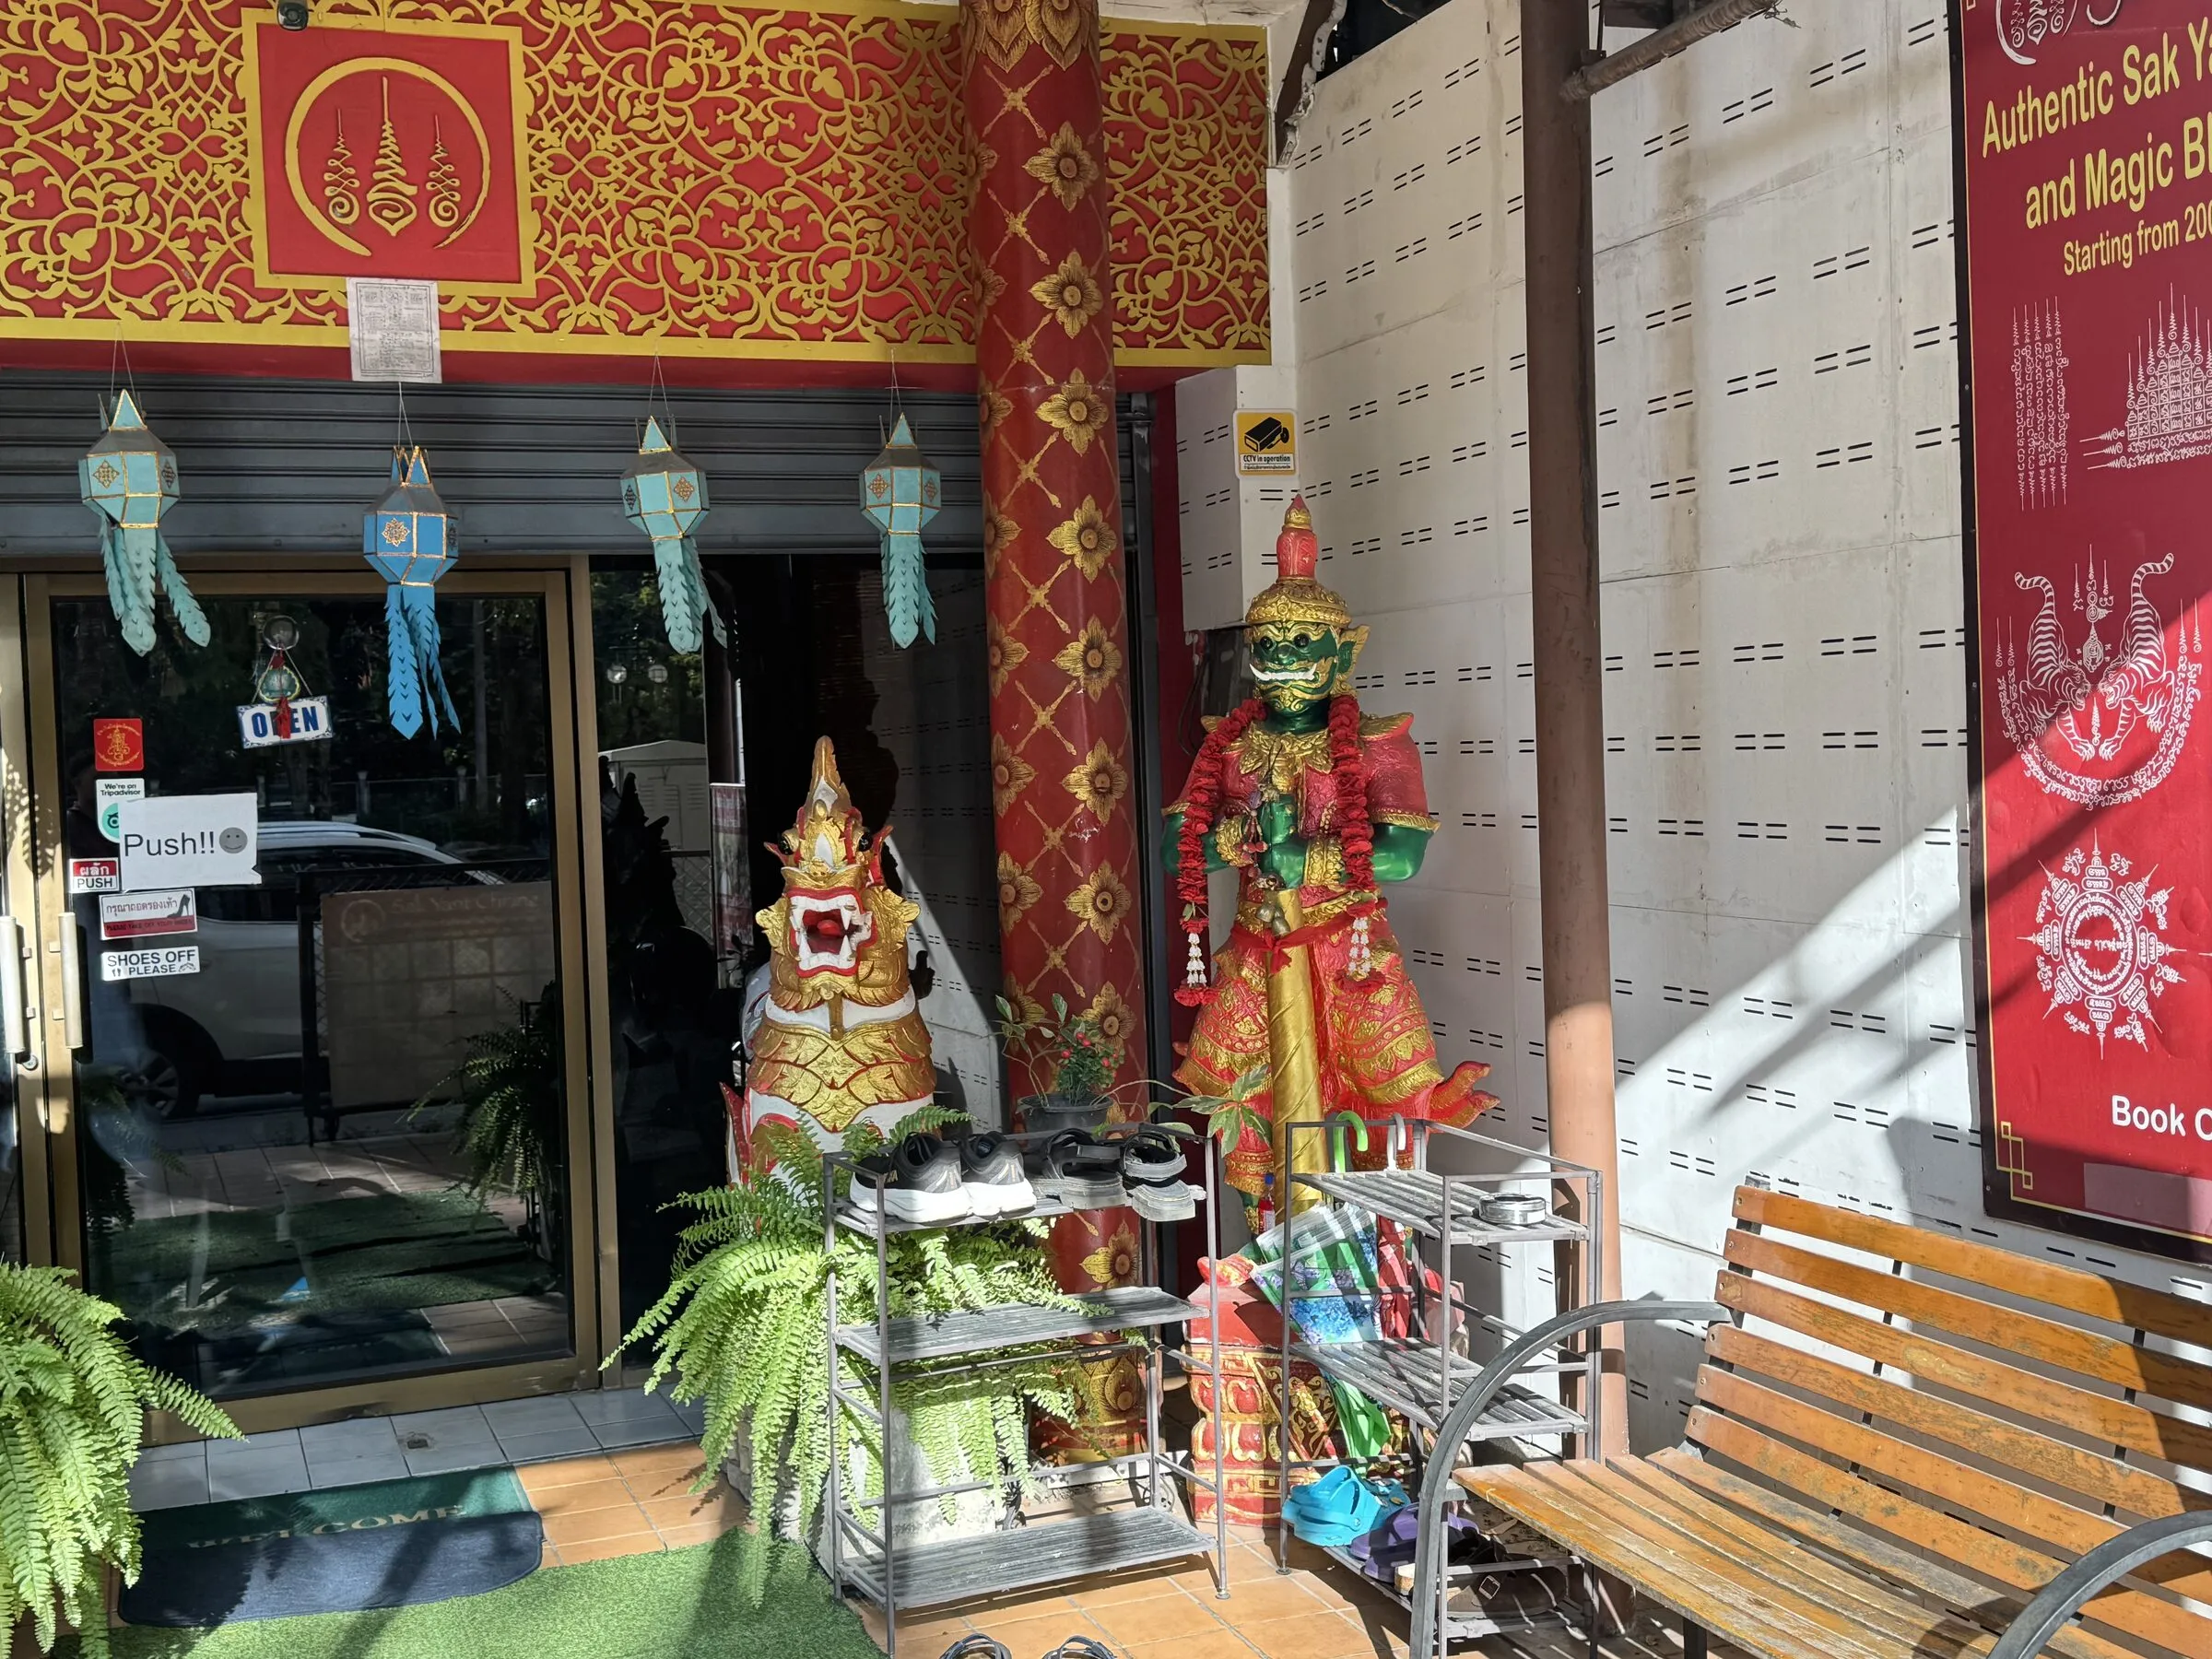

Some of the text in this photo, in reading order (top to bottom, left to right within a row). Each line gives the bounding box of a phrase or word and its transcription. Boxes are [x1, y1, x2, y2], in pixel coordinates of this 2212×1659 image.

[1983, 17, 2212, 159] Authentic Sak Y
[2026, 158, 2076, 229] and
[2085, 132, 2173, 212] Magic
[2064, 230, 2133, 276] Starting
[2136, 219, 2179, 255] from
[1243, 454, 1256, 463] CCTV
[1264, 453, 1290, 464] operation
[124, 831, 215, 857] Push!!
[79, 862, 110, 877] ผลัก
[76, 877, 112, 889] PUSH
[107, 949, 195, 967] SHOES OFF
[128, 964, 177, 975] PLEASE
[2112, 1094, 2186, 1137] Book
[186, 1504, 466, 1548] COME
